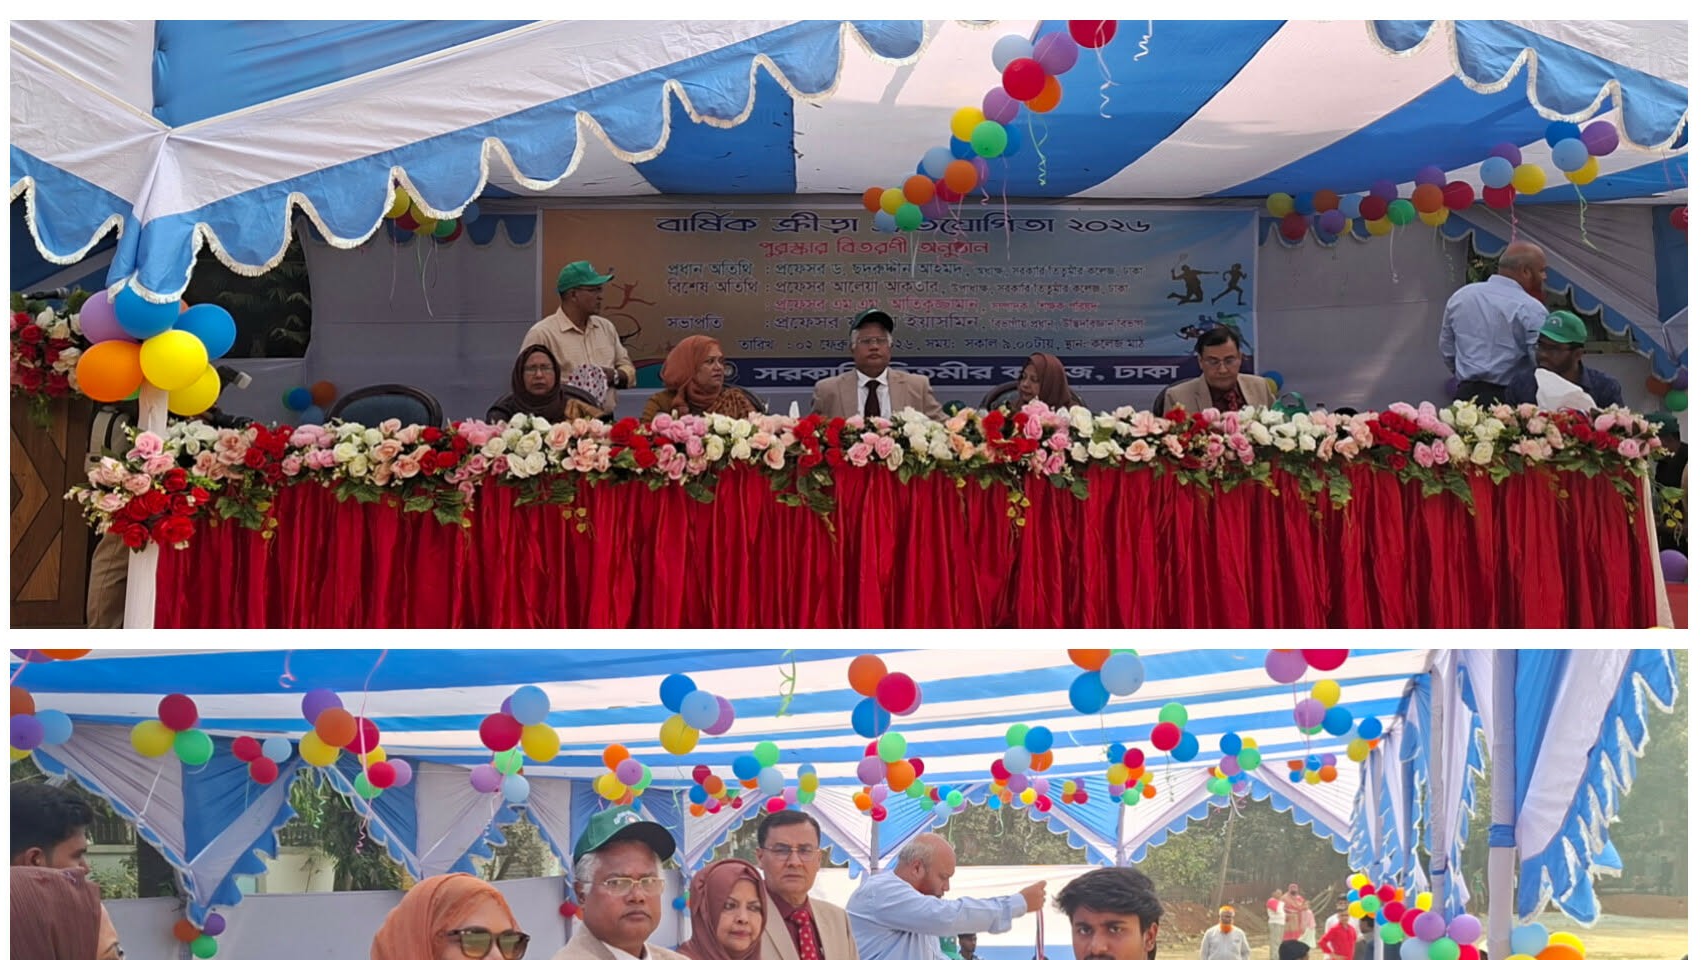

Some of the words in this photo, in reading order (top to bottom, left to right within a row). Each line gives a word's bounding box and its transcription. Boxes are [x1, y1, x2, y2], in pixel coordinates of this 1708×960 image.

[655, 210, 759, 232] বার্ষিক
[771, 210, 859, 233] ক্রীড়া
[1067, 217, 1150, 232] ২০২৬
[759, 241, 828, 257] পুরস্কার
[836, 236, 907, 253] বিতরণী
[667, 263, 703, 276] প্রধান
[708, 259, 753, 275] অতিথি
[775, 263, 826, 276] প্রফেসর
[667, 278, 708, 293] বিশেষ
[713, 278, 759, 292] অতিথি
[775, 280, 826, 293] প্রফেসর
[832, 281, 878, 293] আলেয়া
[667, 314, 724, 329] সভাপতি
[775, 316, 839, 329] প্রফেসর
[738, 338, 775, 350] তারিখ
[796, 341, 813, 350] ০২
[1115, 366, 1180, 379] ঢাকা
